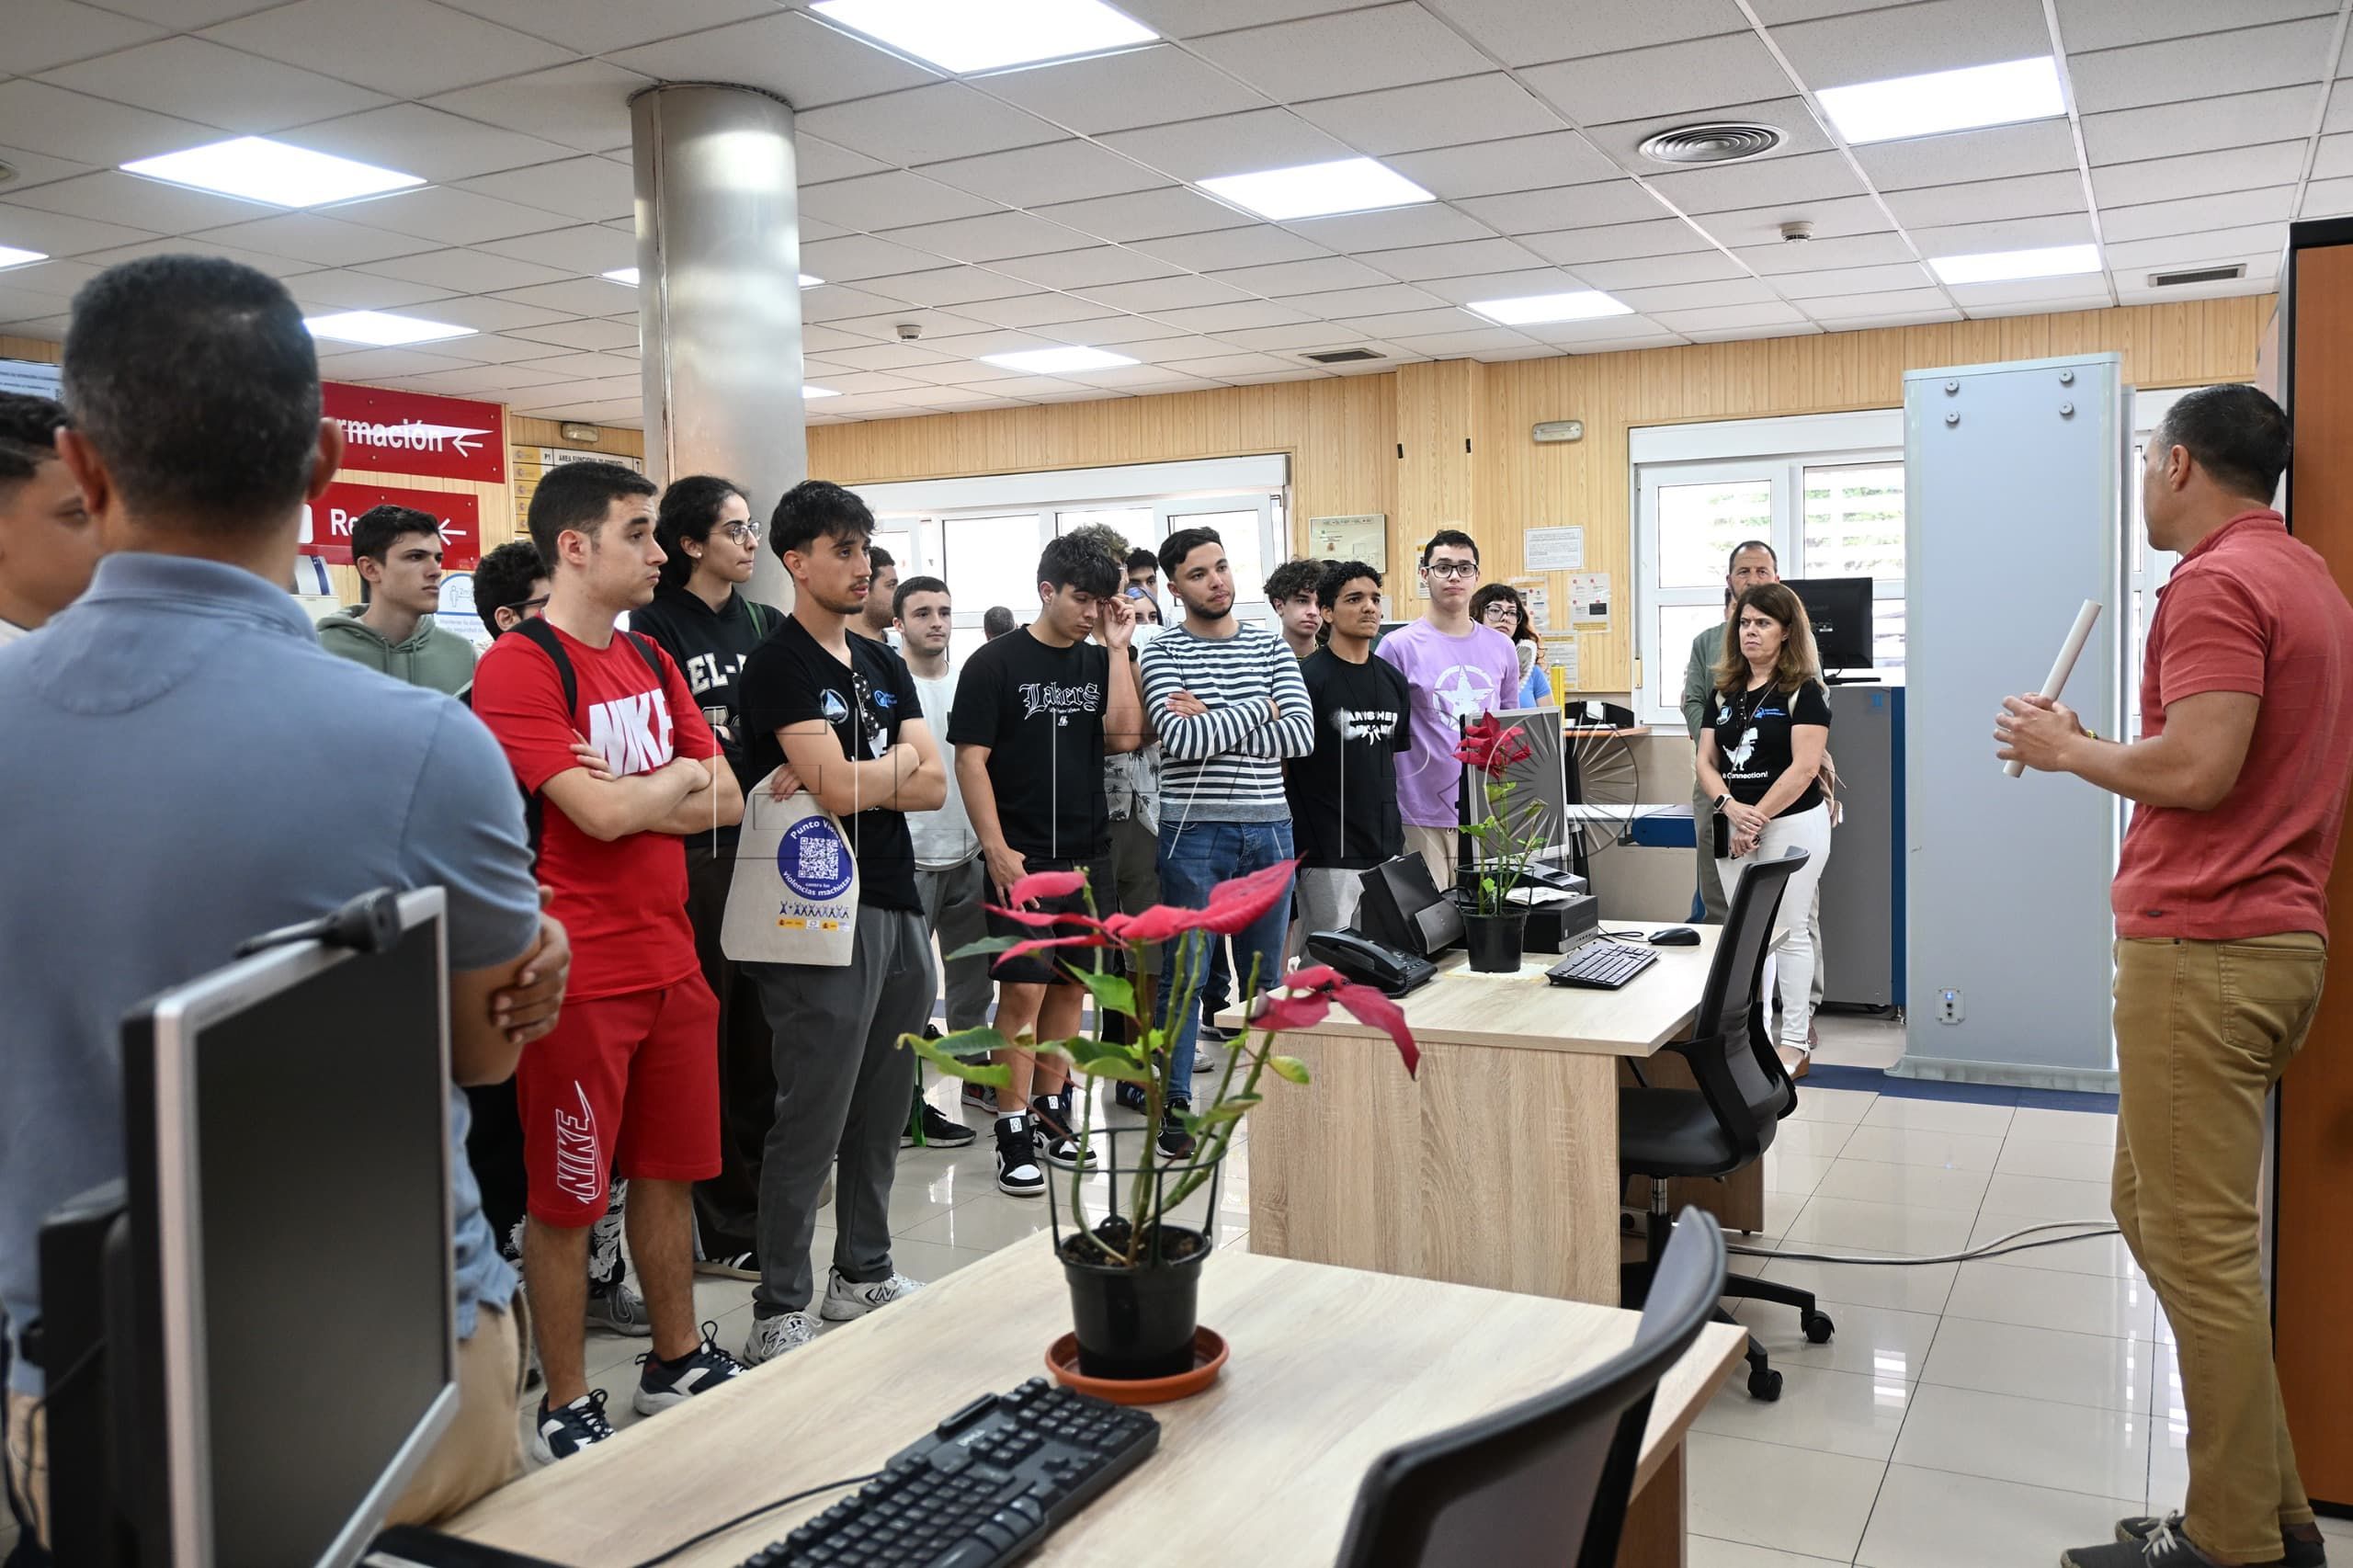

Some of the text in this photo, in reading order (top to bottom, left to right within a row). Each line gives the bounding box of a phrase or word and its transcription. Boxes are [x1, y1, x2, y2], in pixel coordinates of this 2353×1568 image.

[336, 417, 443, 452] rmación
[1018, 681, 1101, 721] Lakers
[588, 687, 675, 778] NIKE
[790, 820, 820, 840] Punto
[782, 869, 851, 896] violencias machistas
[555, 1108, 596, 1198] NIKE
